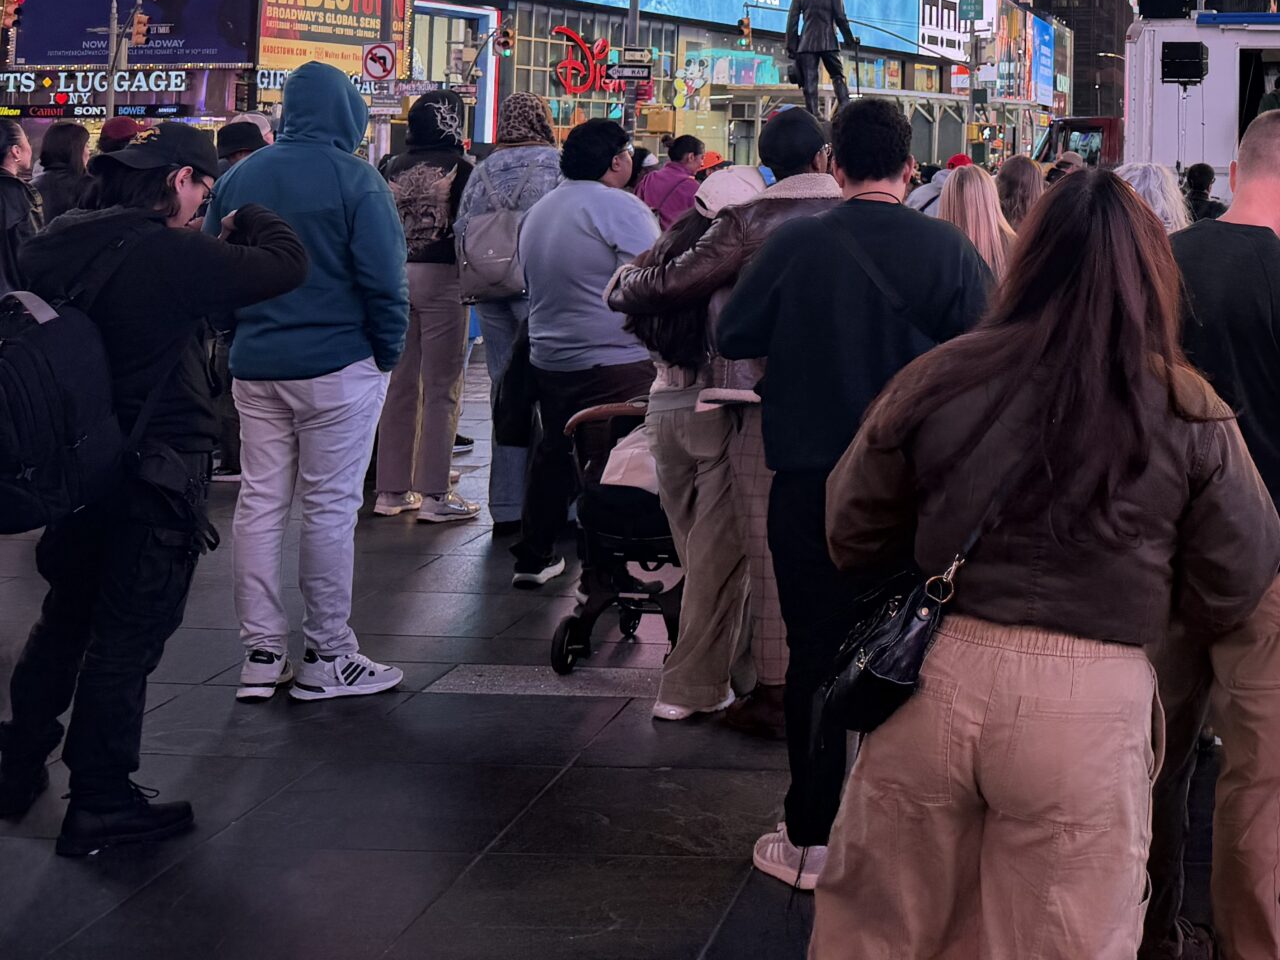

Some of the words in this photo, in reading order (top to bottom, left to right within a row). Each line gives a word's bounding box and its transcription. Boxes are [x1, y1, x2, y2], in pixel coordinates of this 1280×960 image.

[266, 6, 324, 24] BROADWAY'S
[326, 13, 358, 27] GLOBAL
[360, 19, 404, 31] SENSON
[262, 45, 307, 57] HADESTOWN.COM
[0, 73, 35, 92] TS
[57, 71, 186, 93] LUGGAGE
[256, 70, 290, 90] GIF
[50, 93, 56, 104] I
[67, 93, 91, 104] NY
[29, 106, 64, 116] Canon
[118, 106, 146, 116] BOWER
